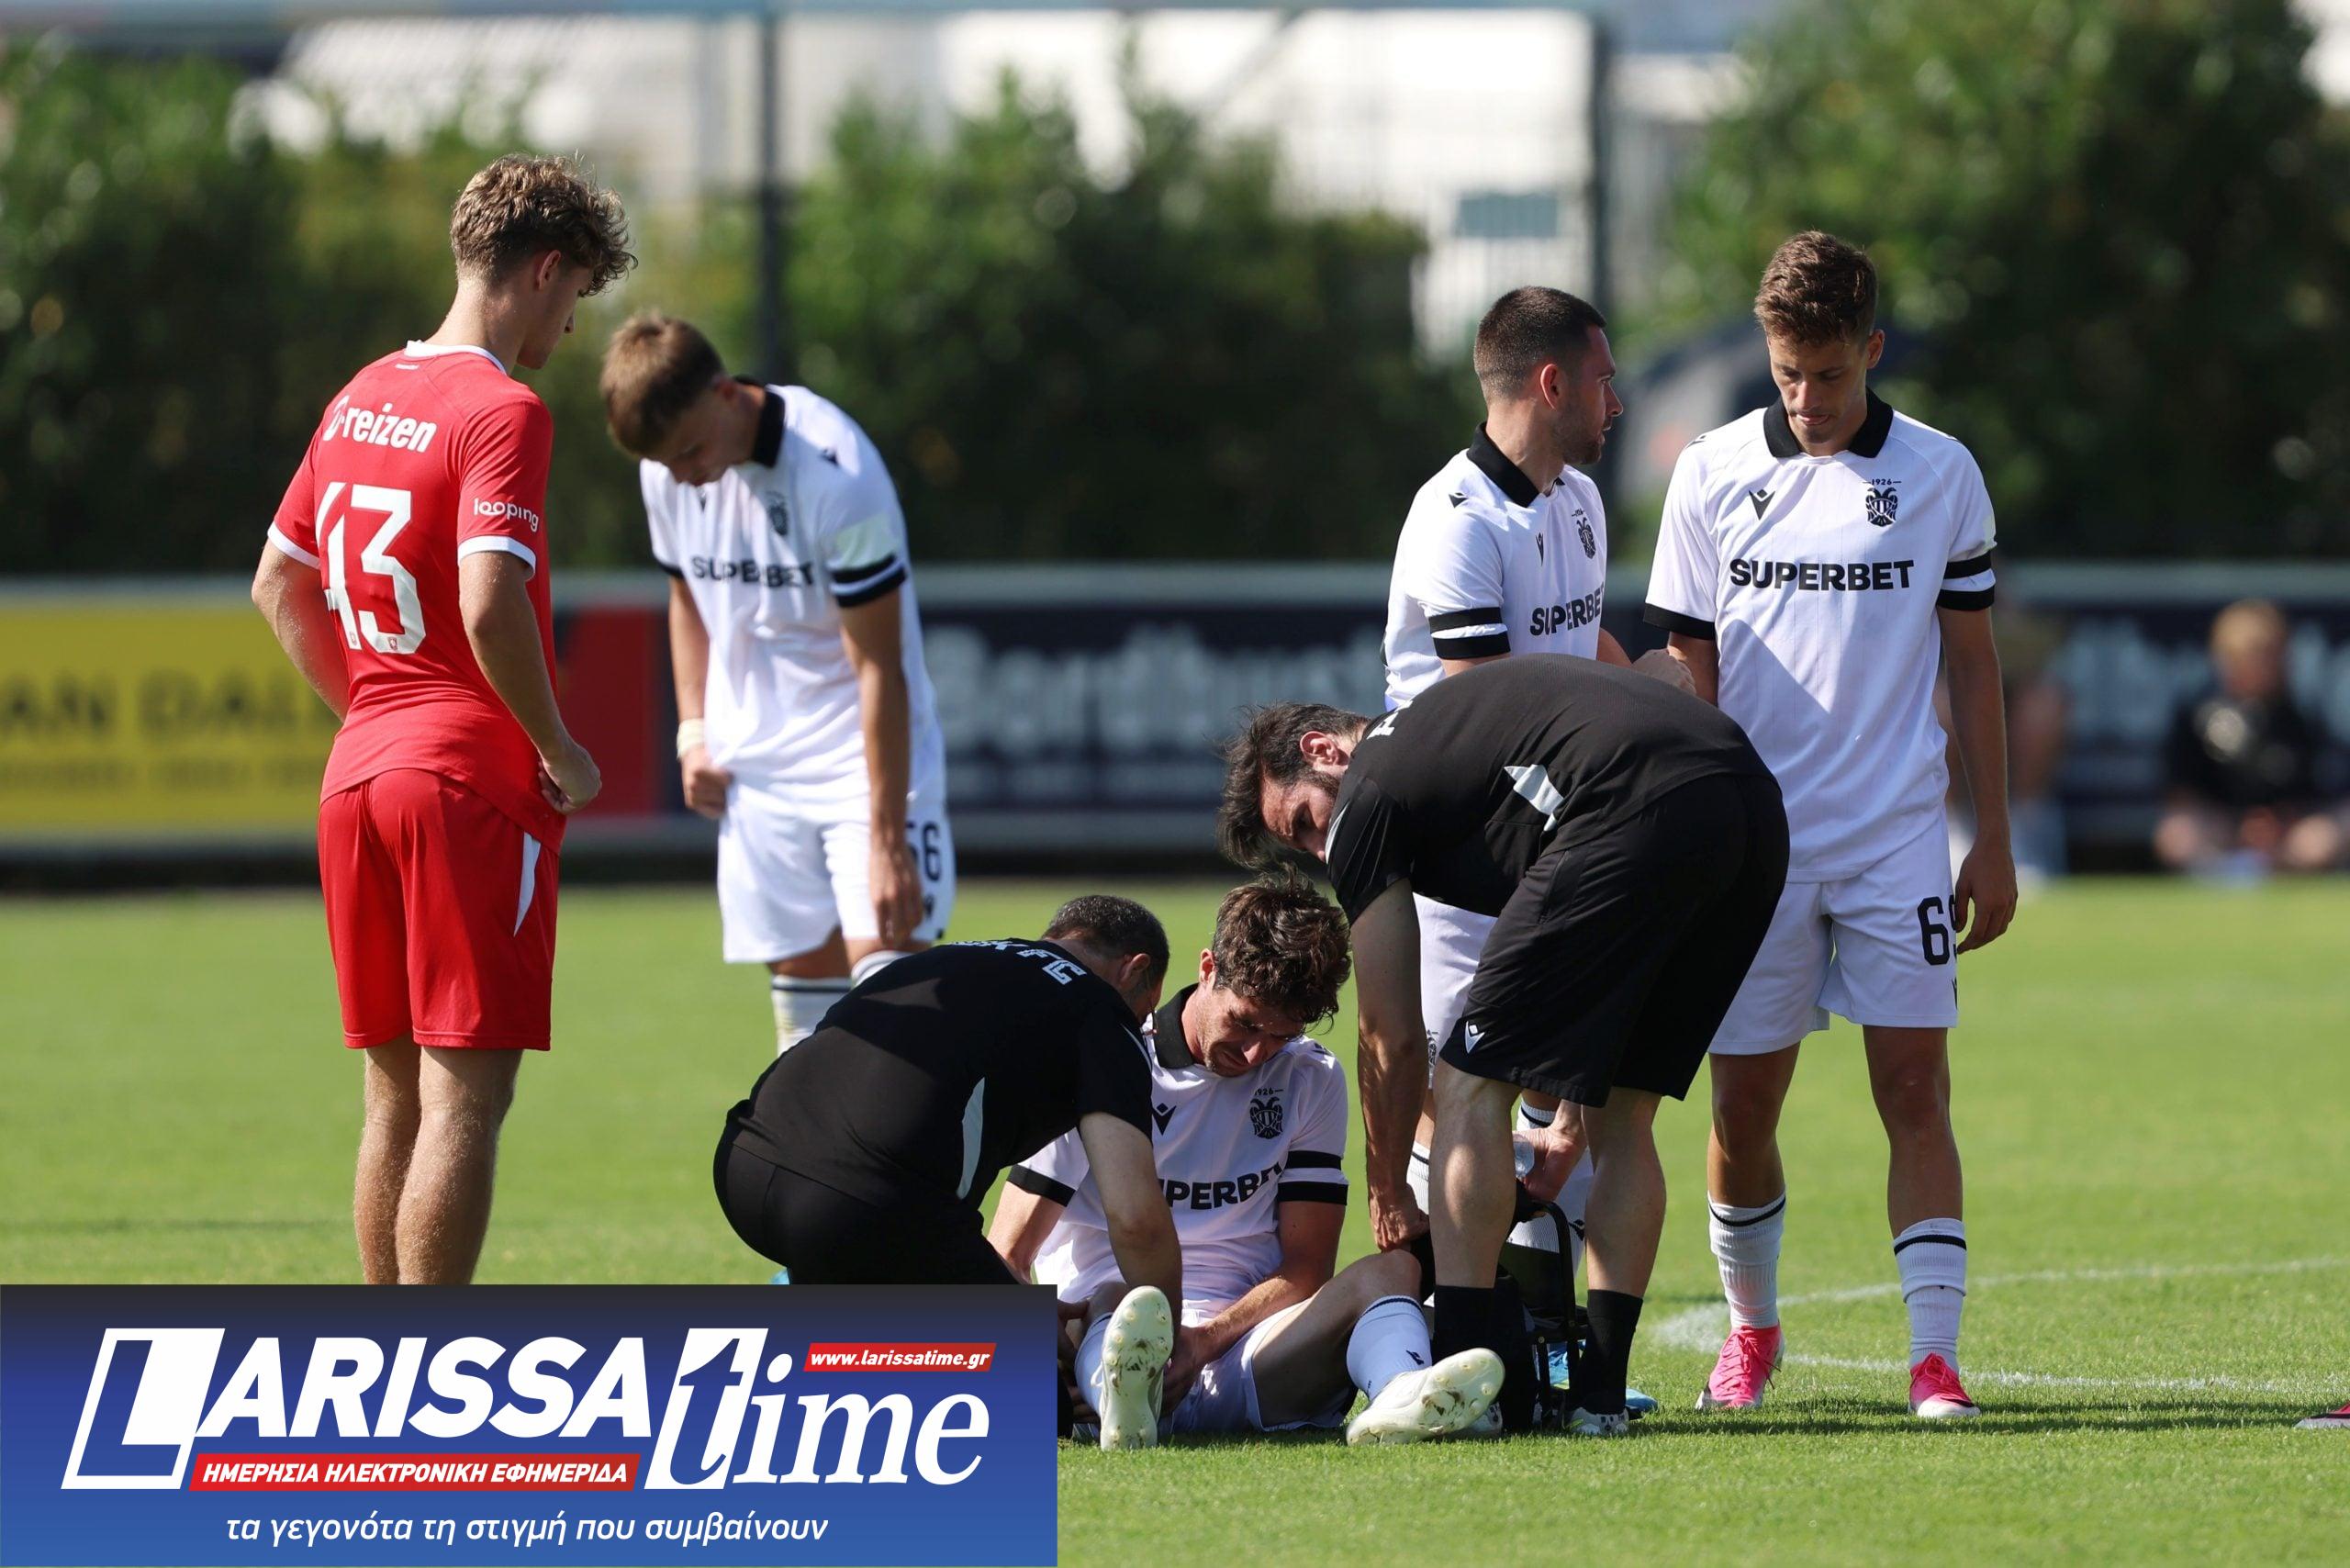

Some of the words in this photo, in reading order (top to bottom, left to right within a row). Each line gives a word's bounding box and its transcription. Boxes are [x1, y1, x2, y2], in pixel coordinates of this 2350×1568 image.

[474, 498, 539, 532] looping
[316, 482, 426, 655] 43
[1729, 558, 1915, 592] SUPERBET
[1158, 1161, 1282, 1210] PERB
